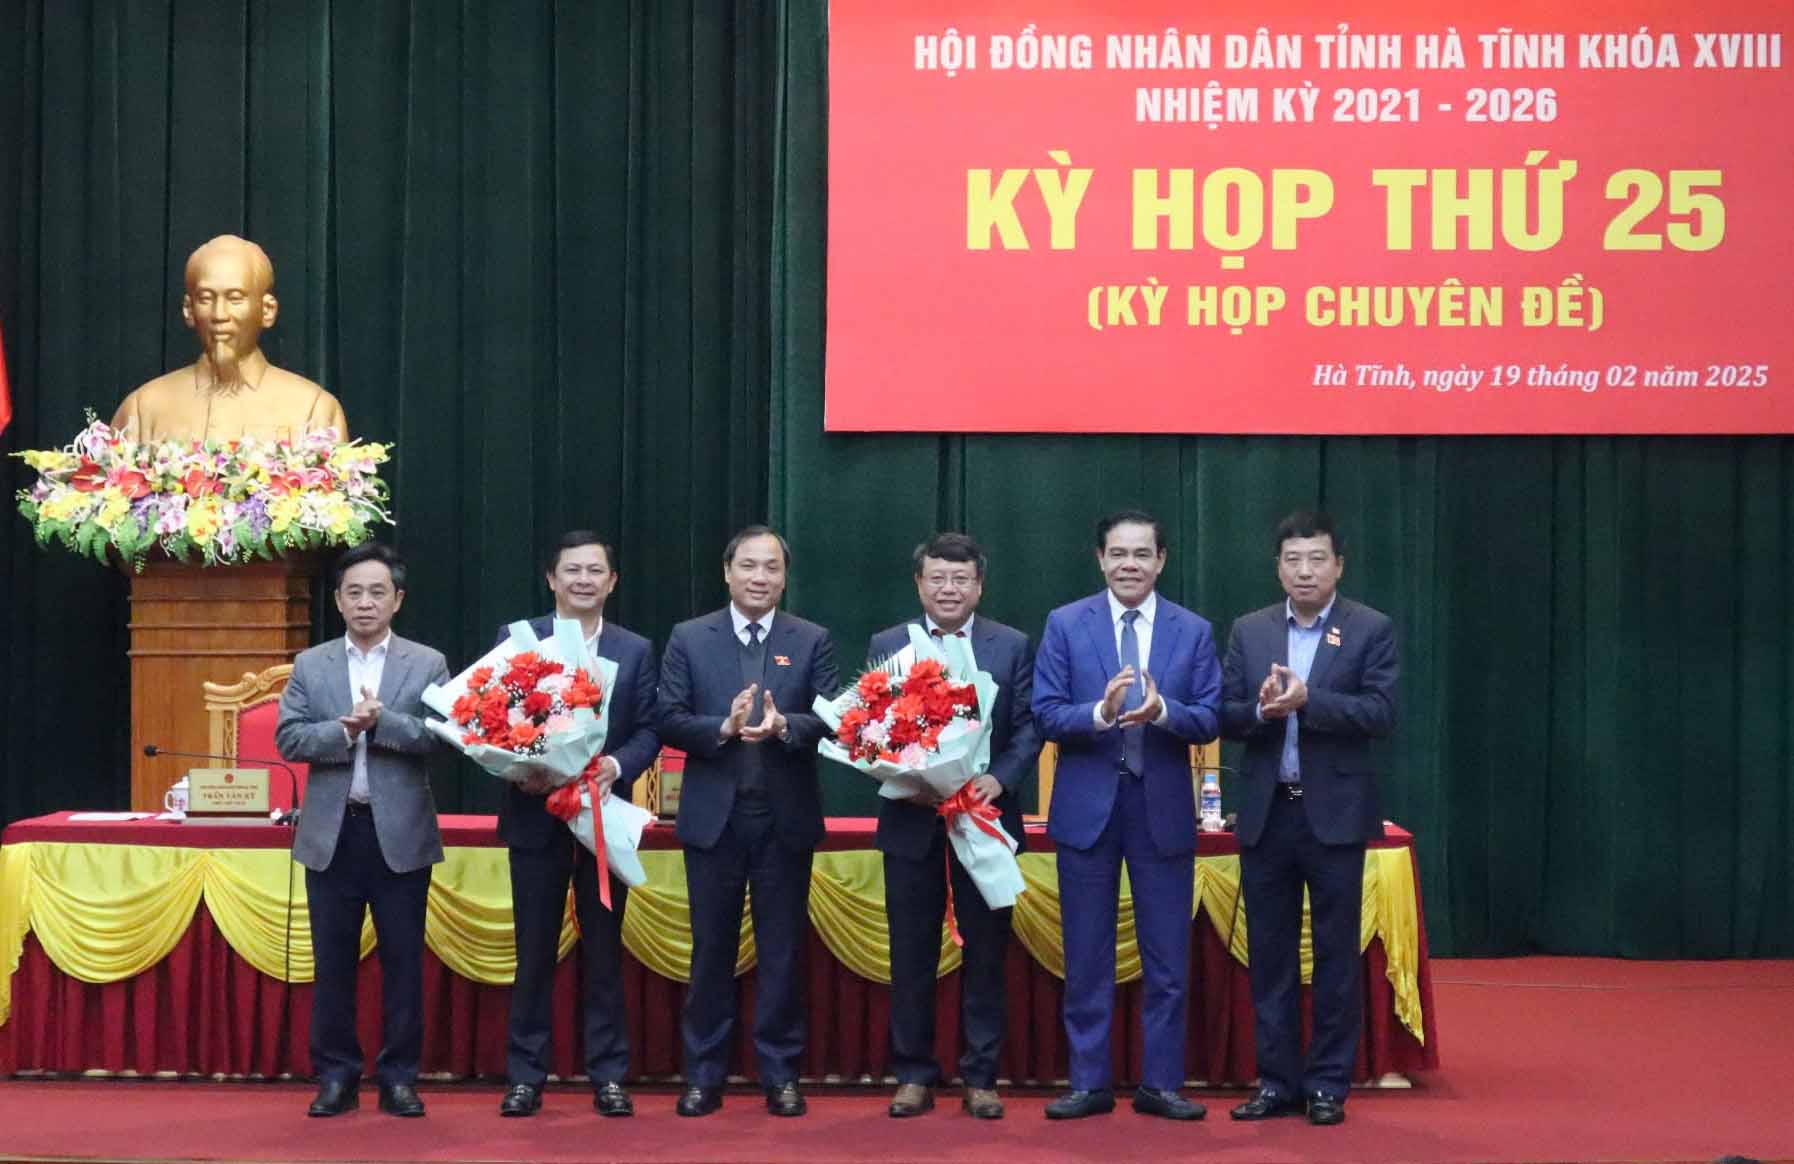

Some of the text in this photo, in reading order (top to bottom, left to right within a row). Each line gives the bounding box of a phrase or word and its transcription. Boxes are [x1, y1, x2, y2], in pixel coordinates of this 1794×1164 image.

[914, 22, 1782, 78] HỘI ĐỒNG NHÂN DÂN TỈNH HÀ TĨNH KHÓA XVIII
[1136, 79, 1558, 131] NHIỆM KỲ 2021 - 2026
[966, 149, 1726, 270] KỲ HỌP THỨ 25
[1088, 273, 1604, 335] (KỲ HỌP CHUYÊN ĐỀ)
[1313, 363, 1769, 393] Hà Tĩnh, ngày 19 tháng 02 năm 2025
